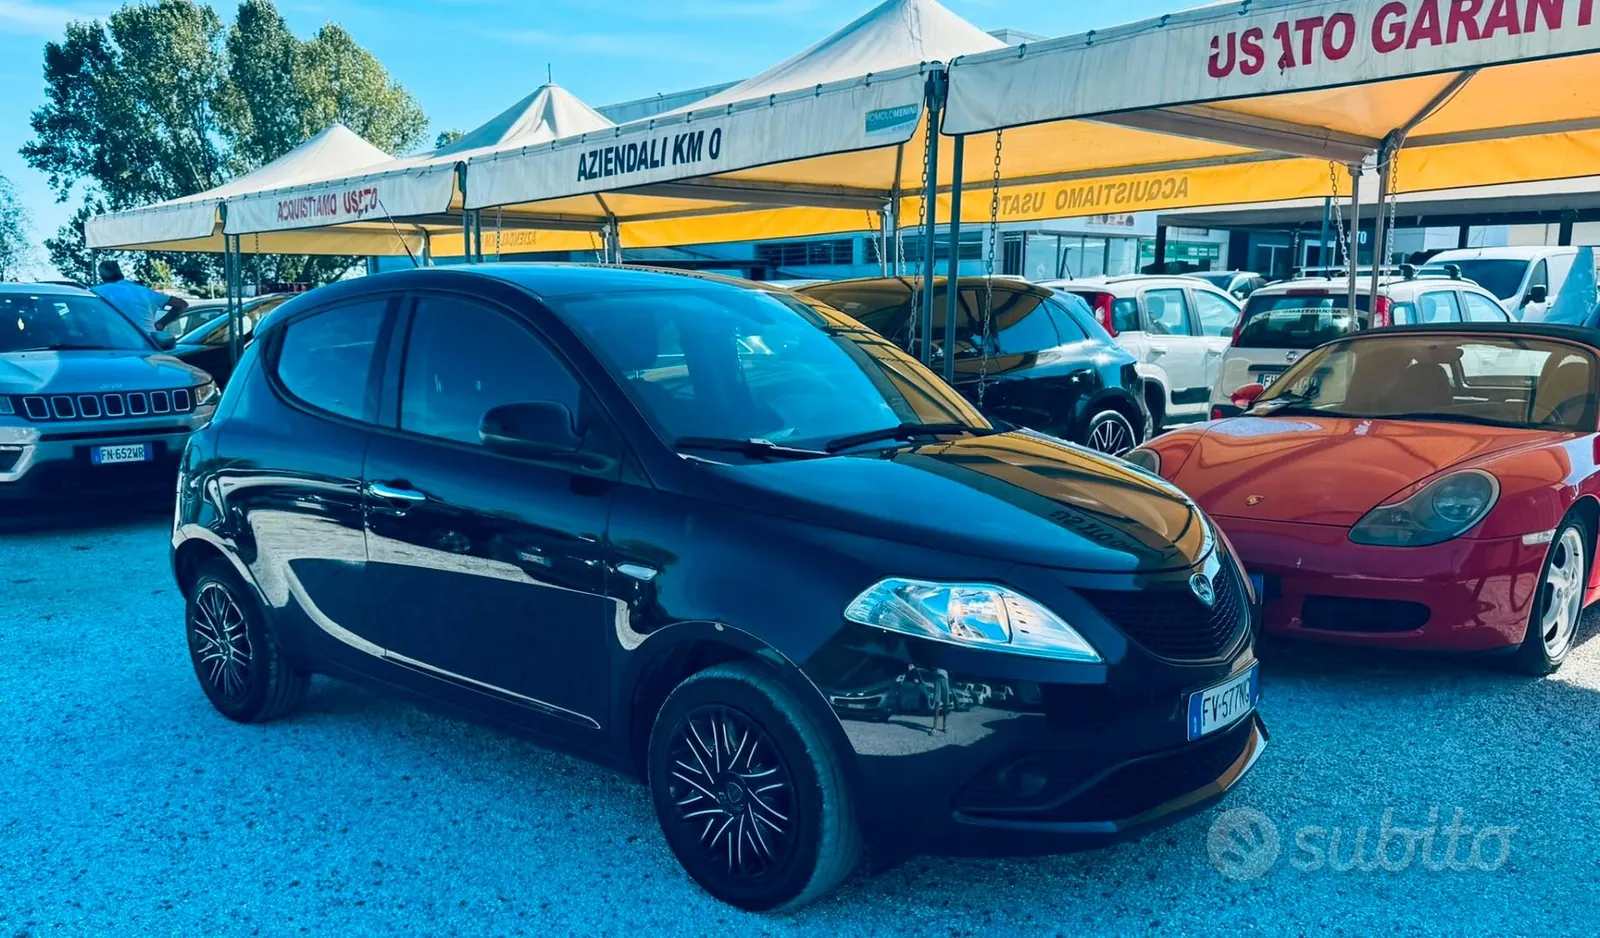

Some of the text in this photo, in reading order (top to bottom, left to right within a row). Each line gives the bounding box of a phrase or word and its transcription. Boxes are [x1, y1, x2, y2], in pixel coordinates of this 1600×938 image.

[1207, 13, 1355, 78] USATO
[577, 127, 721, 181] AZIENDALI KM 0
[277, 193, 337, 221] ACQUISTIAMO
